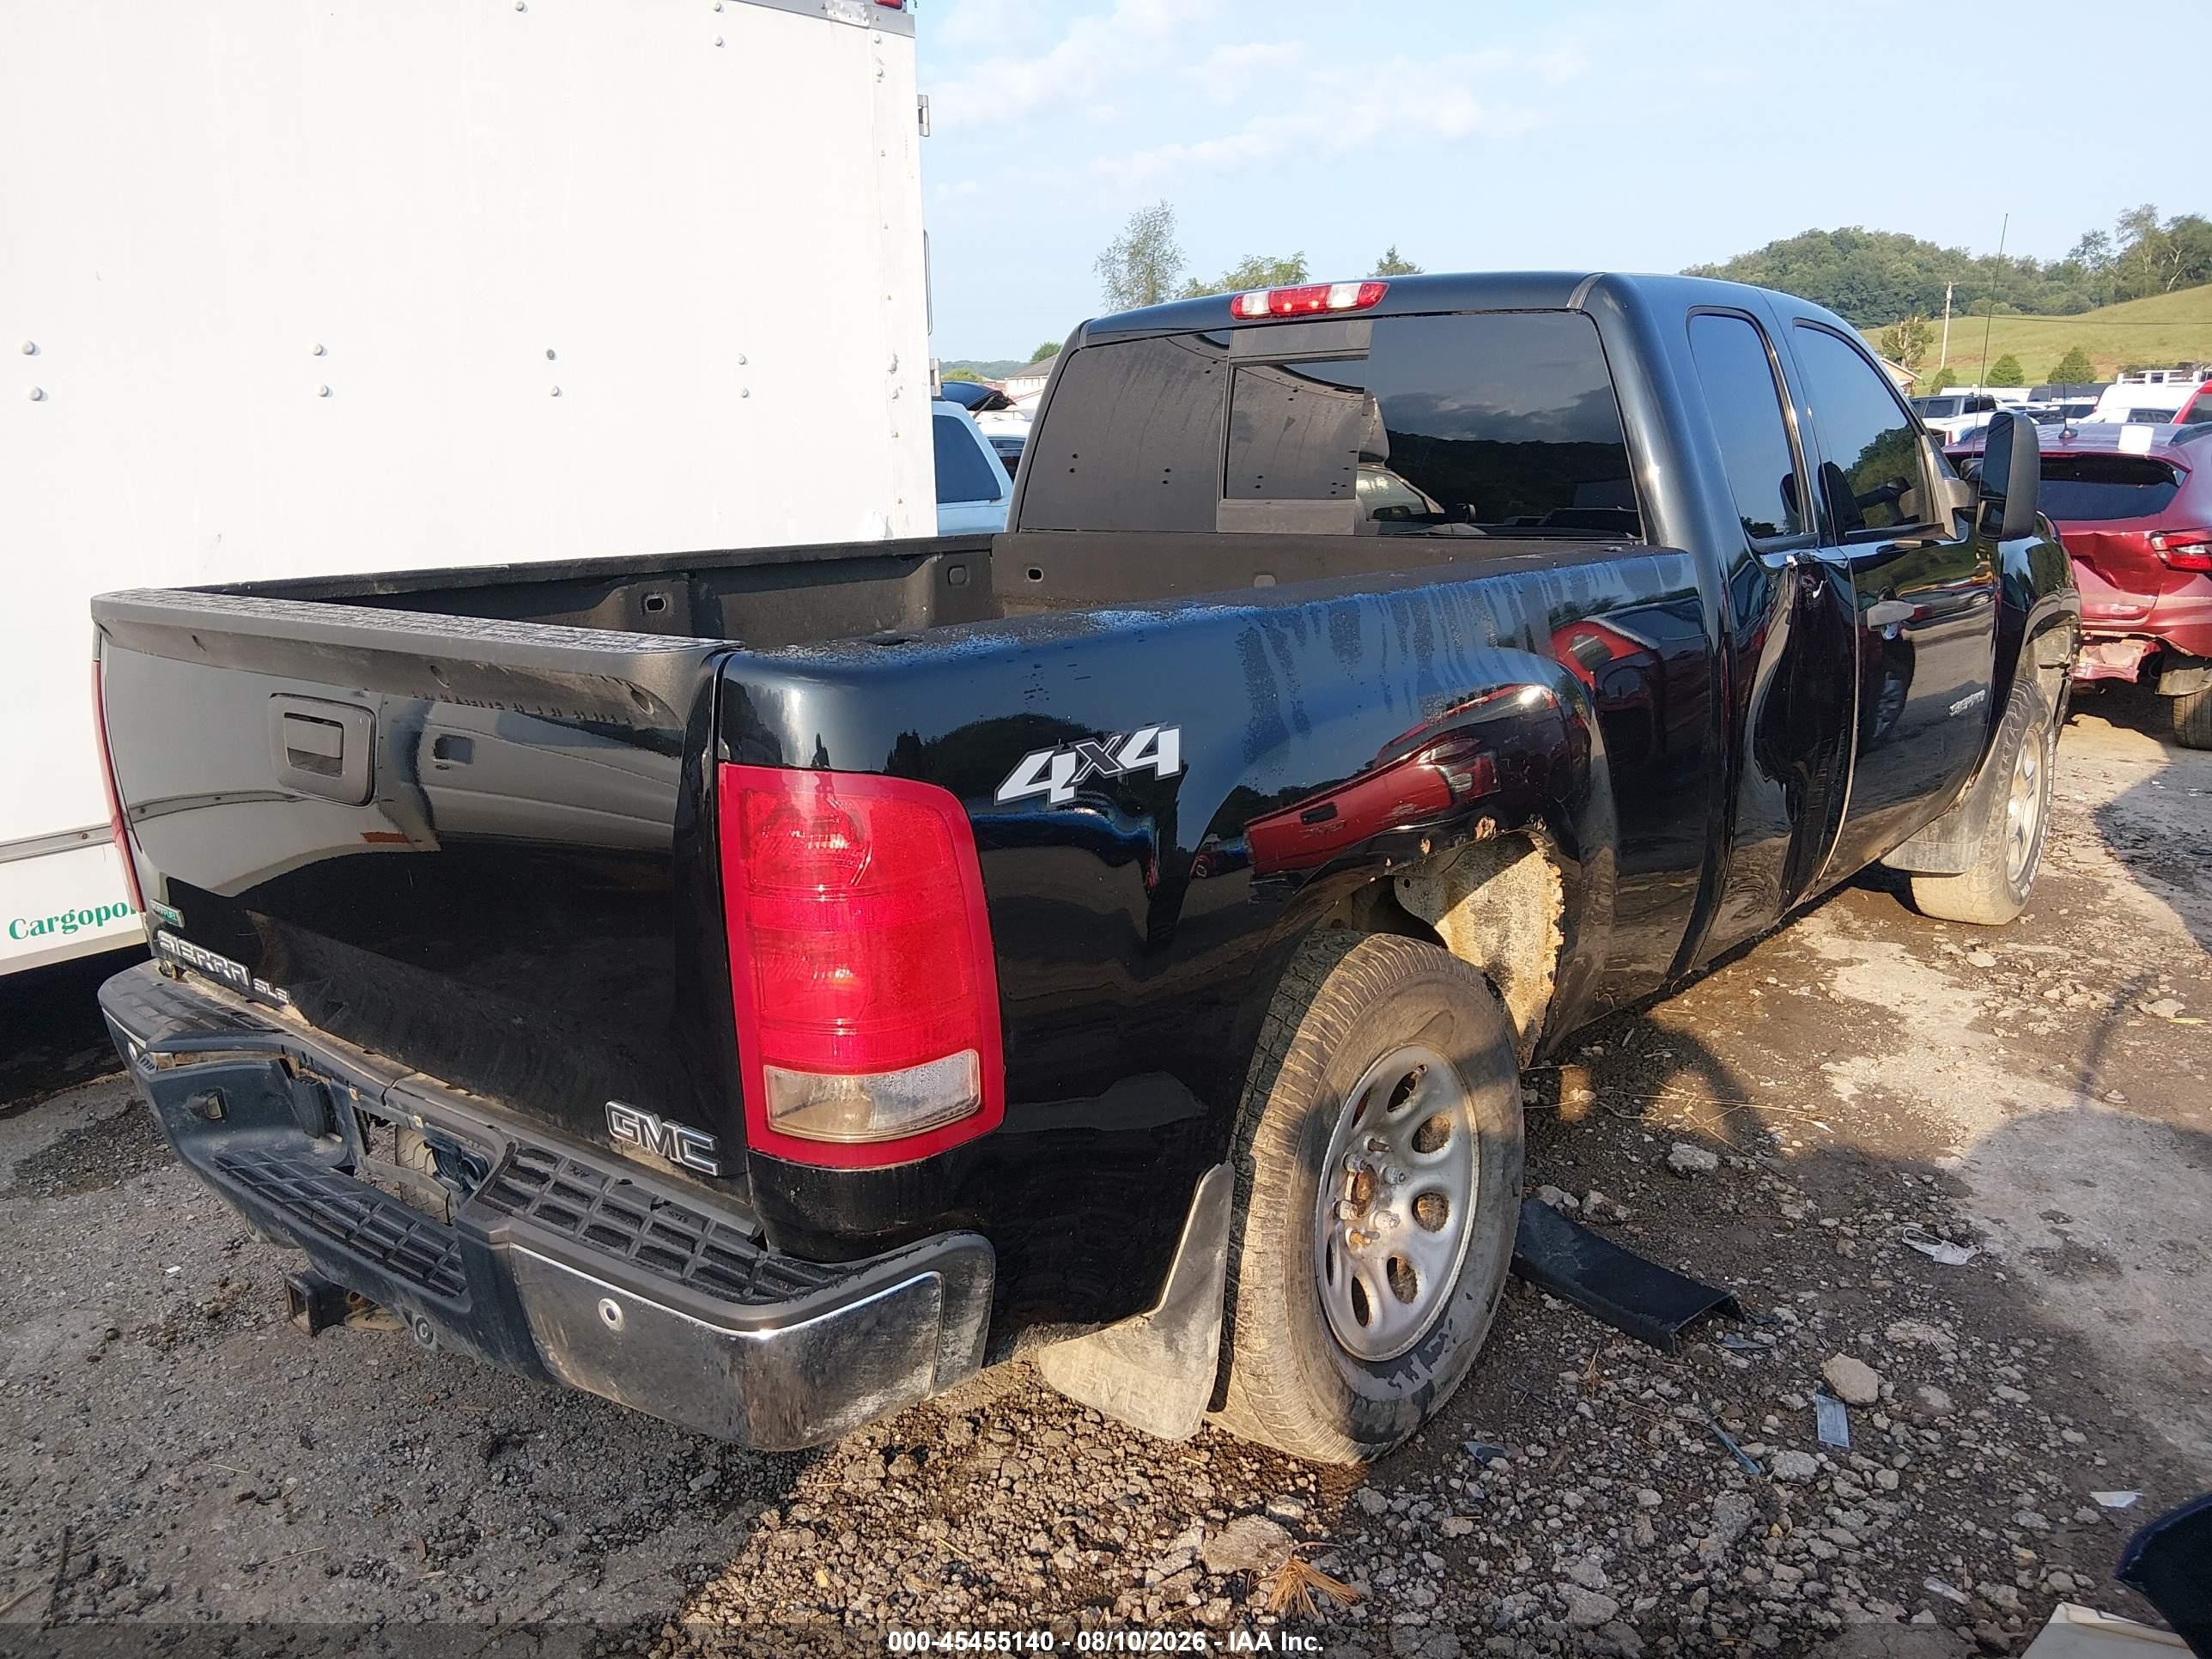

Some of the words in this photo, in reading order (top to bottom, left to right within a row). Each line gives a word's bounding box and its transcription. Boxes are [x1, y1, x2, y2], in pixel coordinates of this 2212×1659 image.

[9, 902, 136, 939] Cargopo
[158, 930, 250, 987] SIERRA
[252, 977, 289, 1004] SLE
[605, 1100, 719, 1176] GMC
